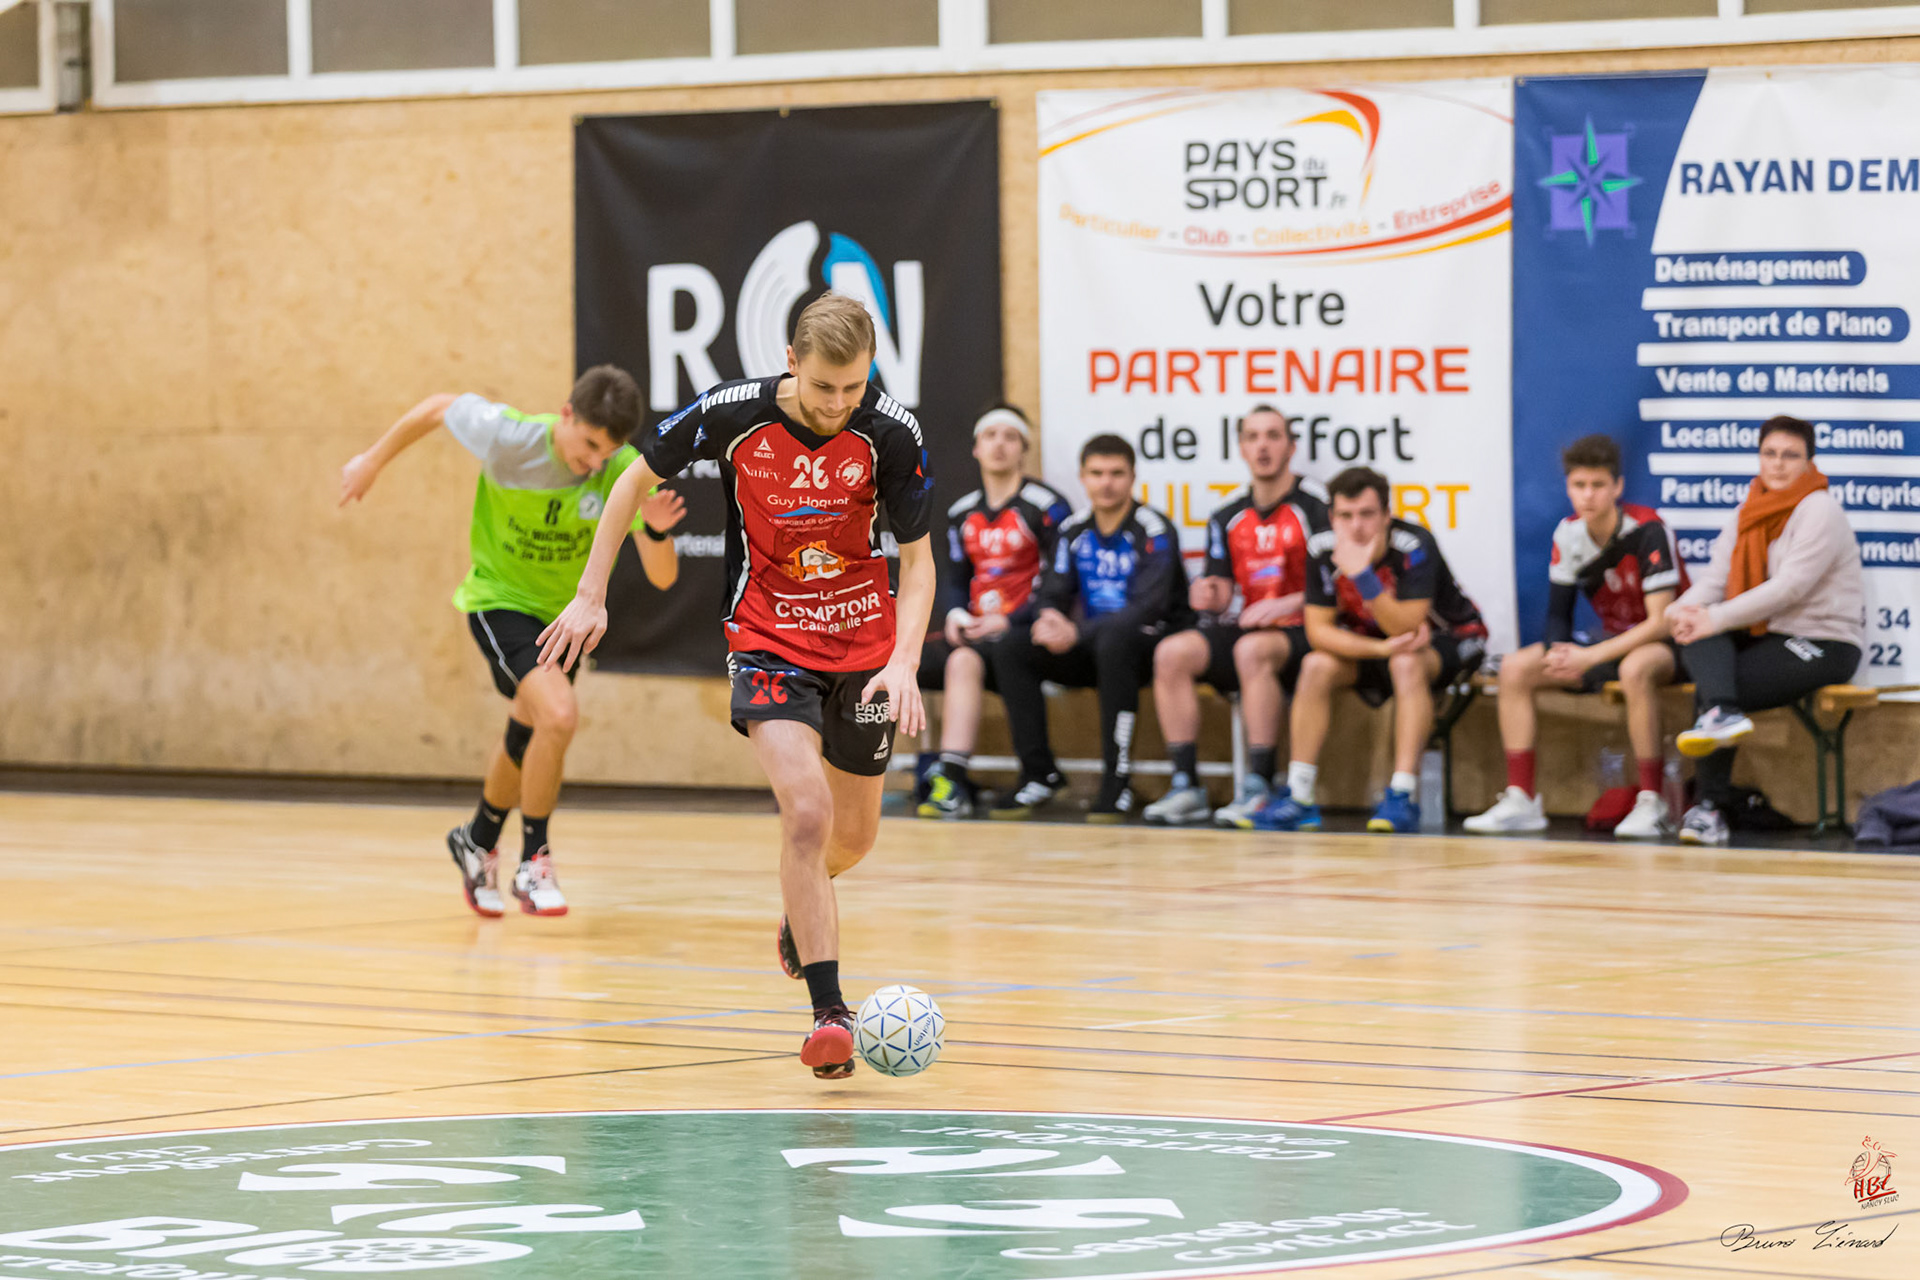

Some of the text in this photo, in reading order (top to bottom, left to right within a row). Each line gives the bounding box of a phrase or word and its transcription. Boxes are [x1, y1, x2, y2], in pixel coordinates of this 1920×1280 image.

[1185, 140, 1296, 173] PAYS
[1680, 157, 1920, 196] RAYAN DEM
[1059, 203, 1161, 240] Particulier
[1183, 226, 1230, 245] Club
[1253, 220, 1371, 246] Collectivité
[1392, 181, 1502, 230] Entreprise
[1655, 255, 1850, 286] Déménagement
[1198, 281, 1347, 328] Votre
[1653, 311, 1893, 342] Transport de Piano
[1088, 347, 1470, 395] PARTENAIRE
[1656, 366, 1890, 394] Vente de Matériels
[1140, 417, 1198, 461] de
[1813, 422, 1904, 450] Camion
[753, 451, 776, 460] SELECT
[789, 454, 829, 490] 26
[767, 494, 796, 509] Guy
[775, 592, 881, 622] COMPTOIR
[1877, 606, 1911, 630] 34
[1868, 643, 1902, 666] 22
[749, 671, 788, 705] 26
[855, 702, 890, 714] PAYS
[913, 1016, 932, 1047] molten
[901, 1126, 1336, 1160] Carrefour
[1034, 1122, 1350, 1146] express
[11, 1138, 433, 1183] Carrefour
[998, 1207, 1430, 1260] Carrefour
[1172, 1219, 1478, 1262] contact
